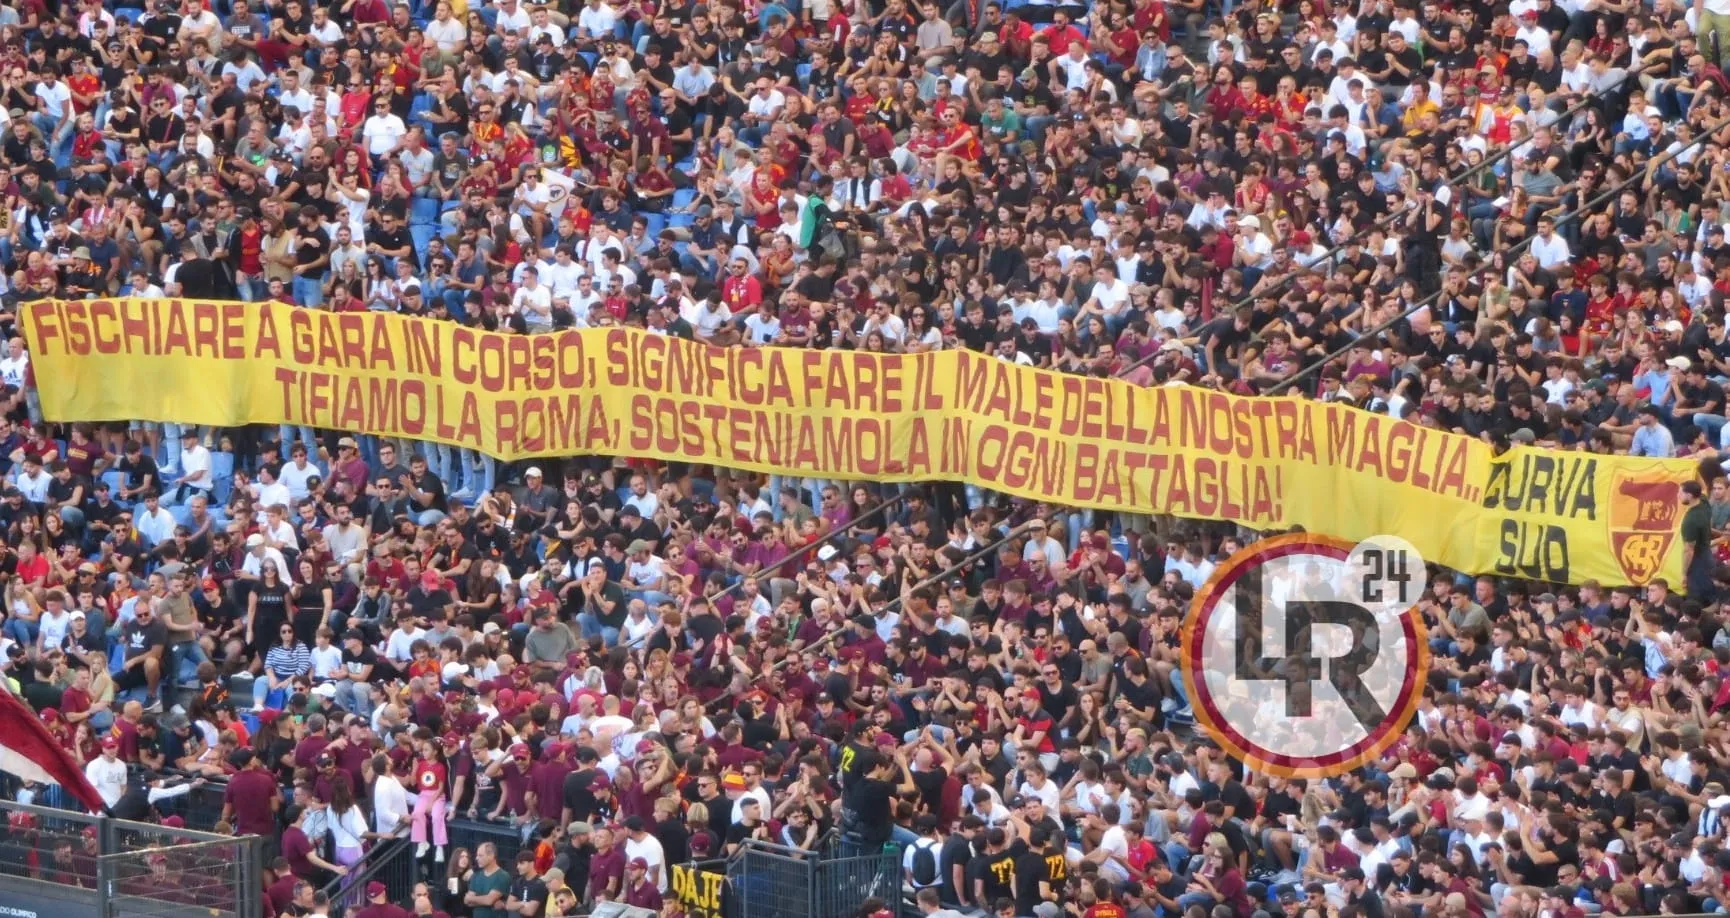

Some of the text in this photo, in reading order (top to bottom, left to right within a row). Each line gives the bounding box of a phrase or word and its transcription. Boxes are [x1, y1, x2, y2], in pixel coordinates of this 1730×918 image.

[32, 302, 245, 359] FISCHIARE
[255, 304, 281, 358] A
[291, 313, 395, 370] GARA
[402, 319, 441, 377] IN
[452, 329, 596, 392] CORSO,
[606, 329, 793, 407] SIGNIFICA
[802, 351, 903, 413] FARE
[912, 352, 943, 411] IL
[954, 352, 1054, 429] MALE
[1060, 377, 1171, 446] DELLA
[1179, 390, 1317, 464] NOSTRA
[275, 367, 1282, 522] TIFIAMO LA ROMA, SOSTENIAMOLA IN OGNI BATTAGLIA!
[1483, 454, 1597, 520] CURVA
[1495, 519, 1569, 583] SUD
[672, 865, 723, 909] DAJE
[1045, 855, 1065, 879] 72
